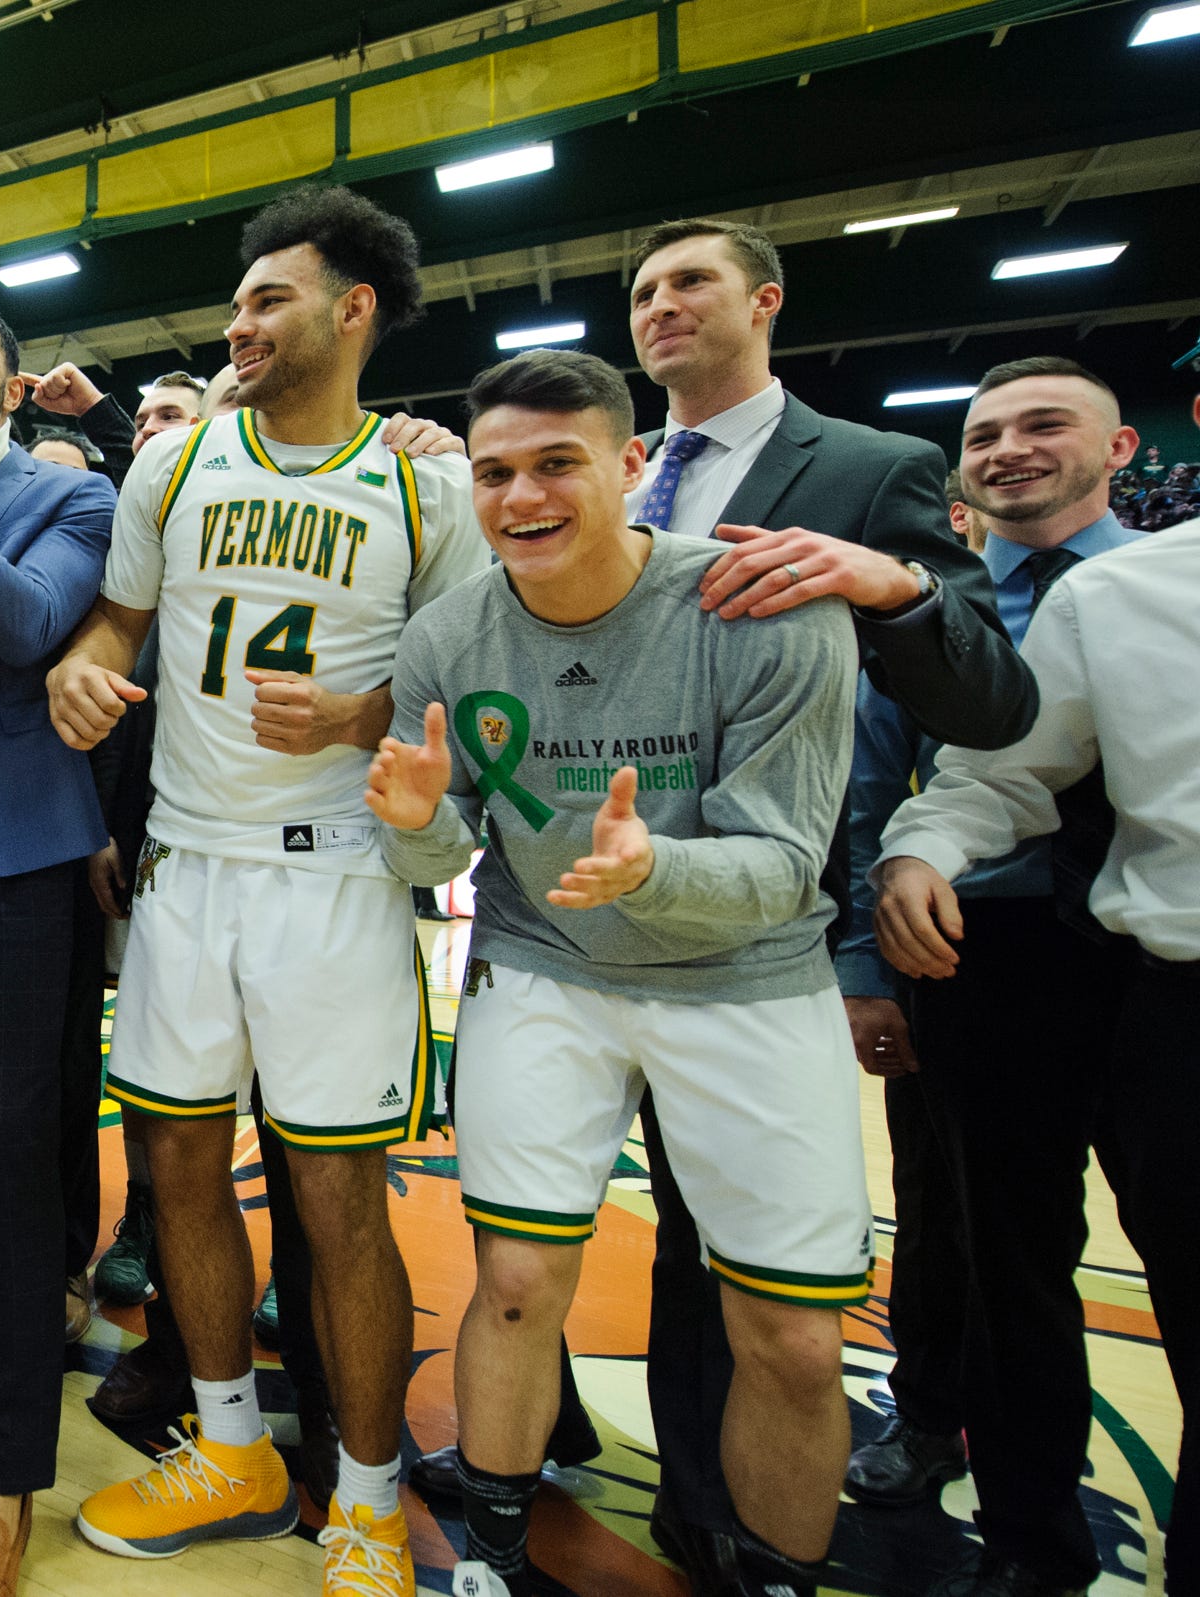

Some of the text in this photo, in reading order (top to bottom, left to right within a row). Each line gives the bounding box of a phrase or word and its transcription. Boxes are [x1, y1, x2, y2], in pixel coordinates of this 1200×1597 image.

[198, 499, 369, 590] VERMONT
[200, 594, 317, 699] 14
[555, 676, 598, 688] adidas
[533, 732, 699, 759] RALLY AROUND
[556, 761, 627, 793] ment
[332, 830, 339, 839] L
